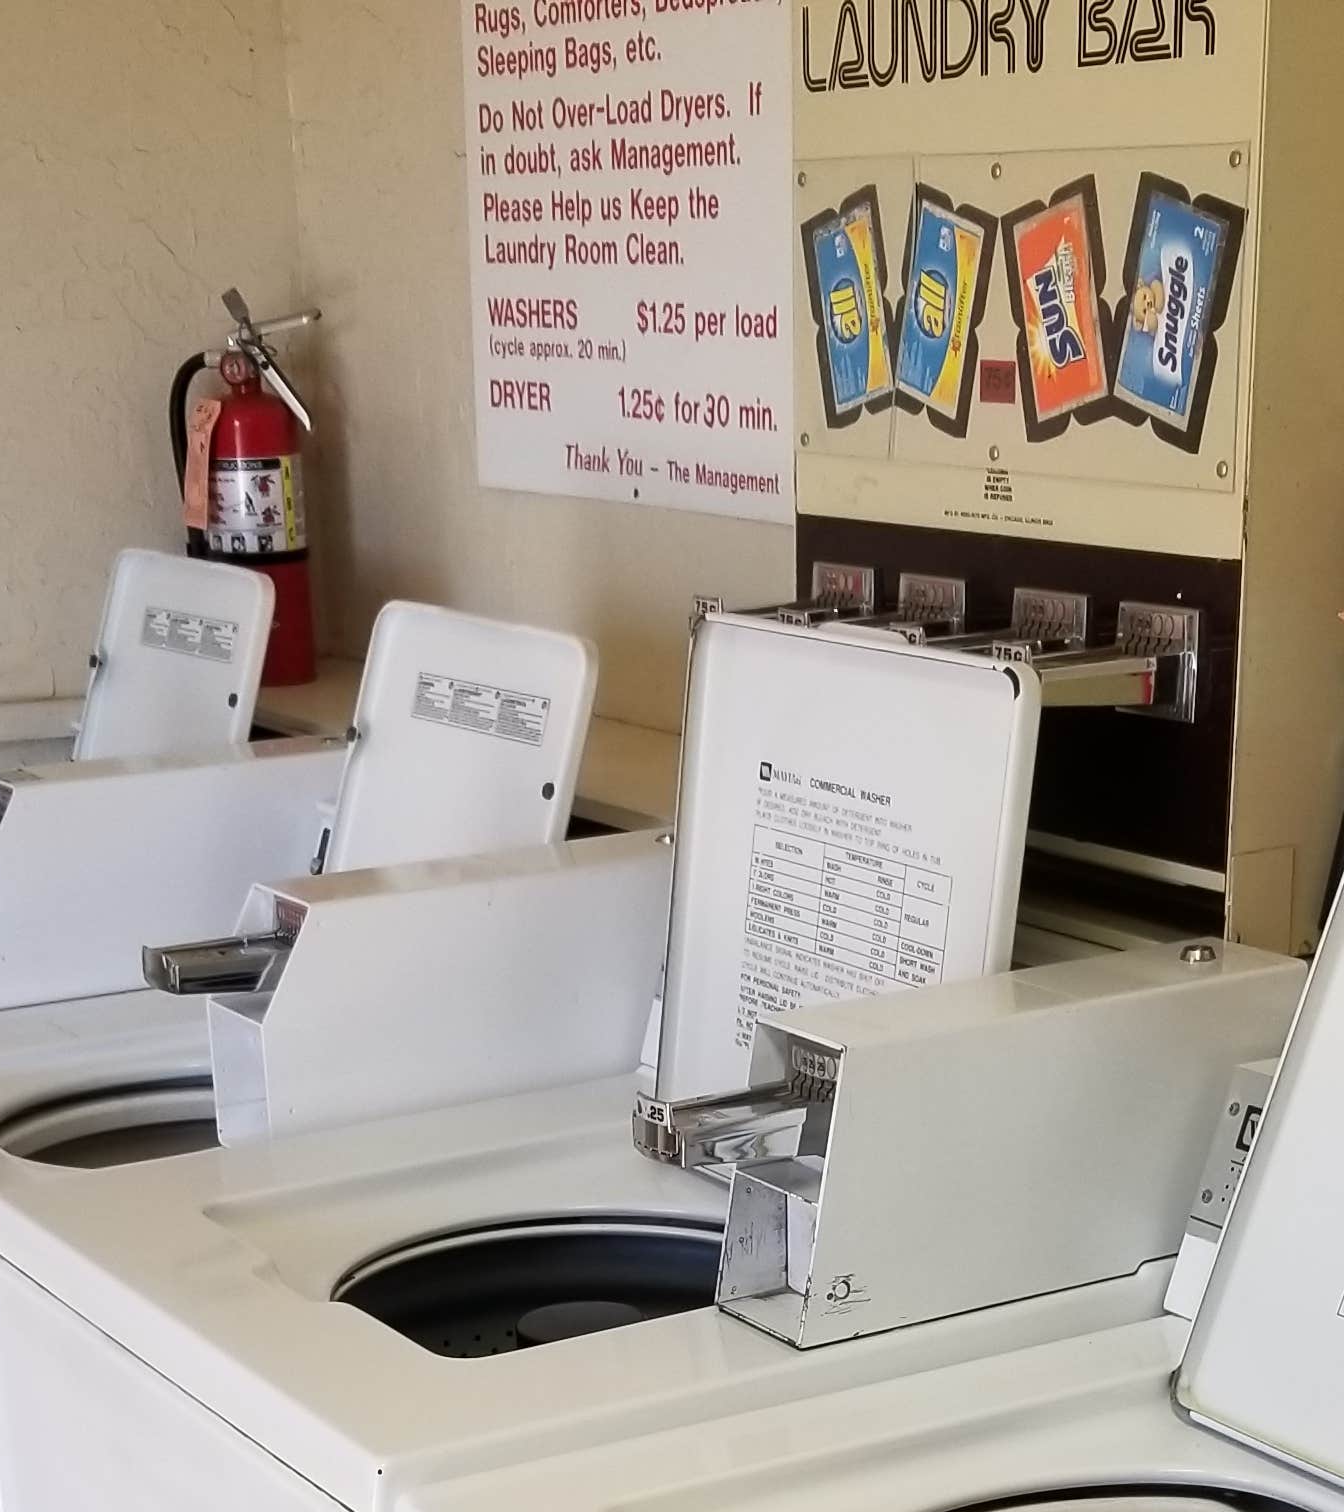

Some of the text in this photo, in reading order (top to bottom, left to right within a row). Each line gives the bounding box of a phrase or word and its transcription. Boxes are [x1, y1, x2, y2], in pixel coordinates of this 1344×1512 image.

[475, 3, 527, 39] Rugs,
[534, 0, 647, 29] Comforters,
[477, 30, 662, 79] Sleeping Bags, etc.
[802, 0, 1216, 92] LAUNDRY BAR
[479, 81, 763, 134] Do Not Over-Load Dryers. If
[480, 132, 742, 178] in doubt, ask Management.
[483, 185, 720, 226] Please Help us Keep the
[485, 232, 685, 270] Laundry Room Clean.
[487, 297, 778, 342] WASHERS $1.25 per load
[830, 286, 863, 340] all
[919, 270, 948, 339] all
[1157, 254, 1190, 374] Snuggle
[1191, 287, 1206, 329] Sheets
[489, 334, 627, 363] (cycle approx. 20 min.)
[490, 379, 779, 432] DRYER 1.25¢ for 30 min.
[565, 443, 781, 496] Thank You The Management
[809, 777, 892, 808] COMMERCIAL WASHER
